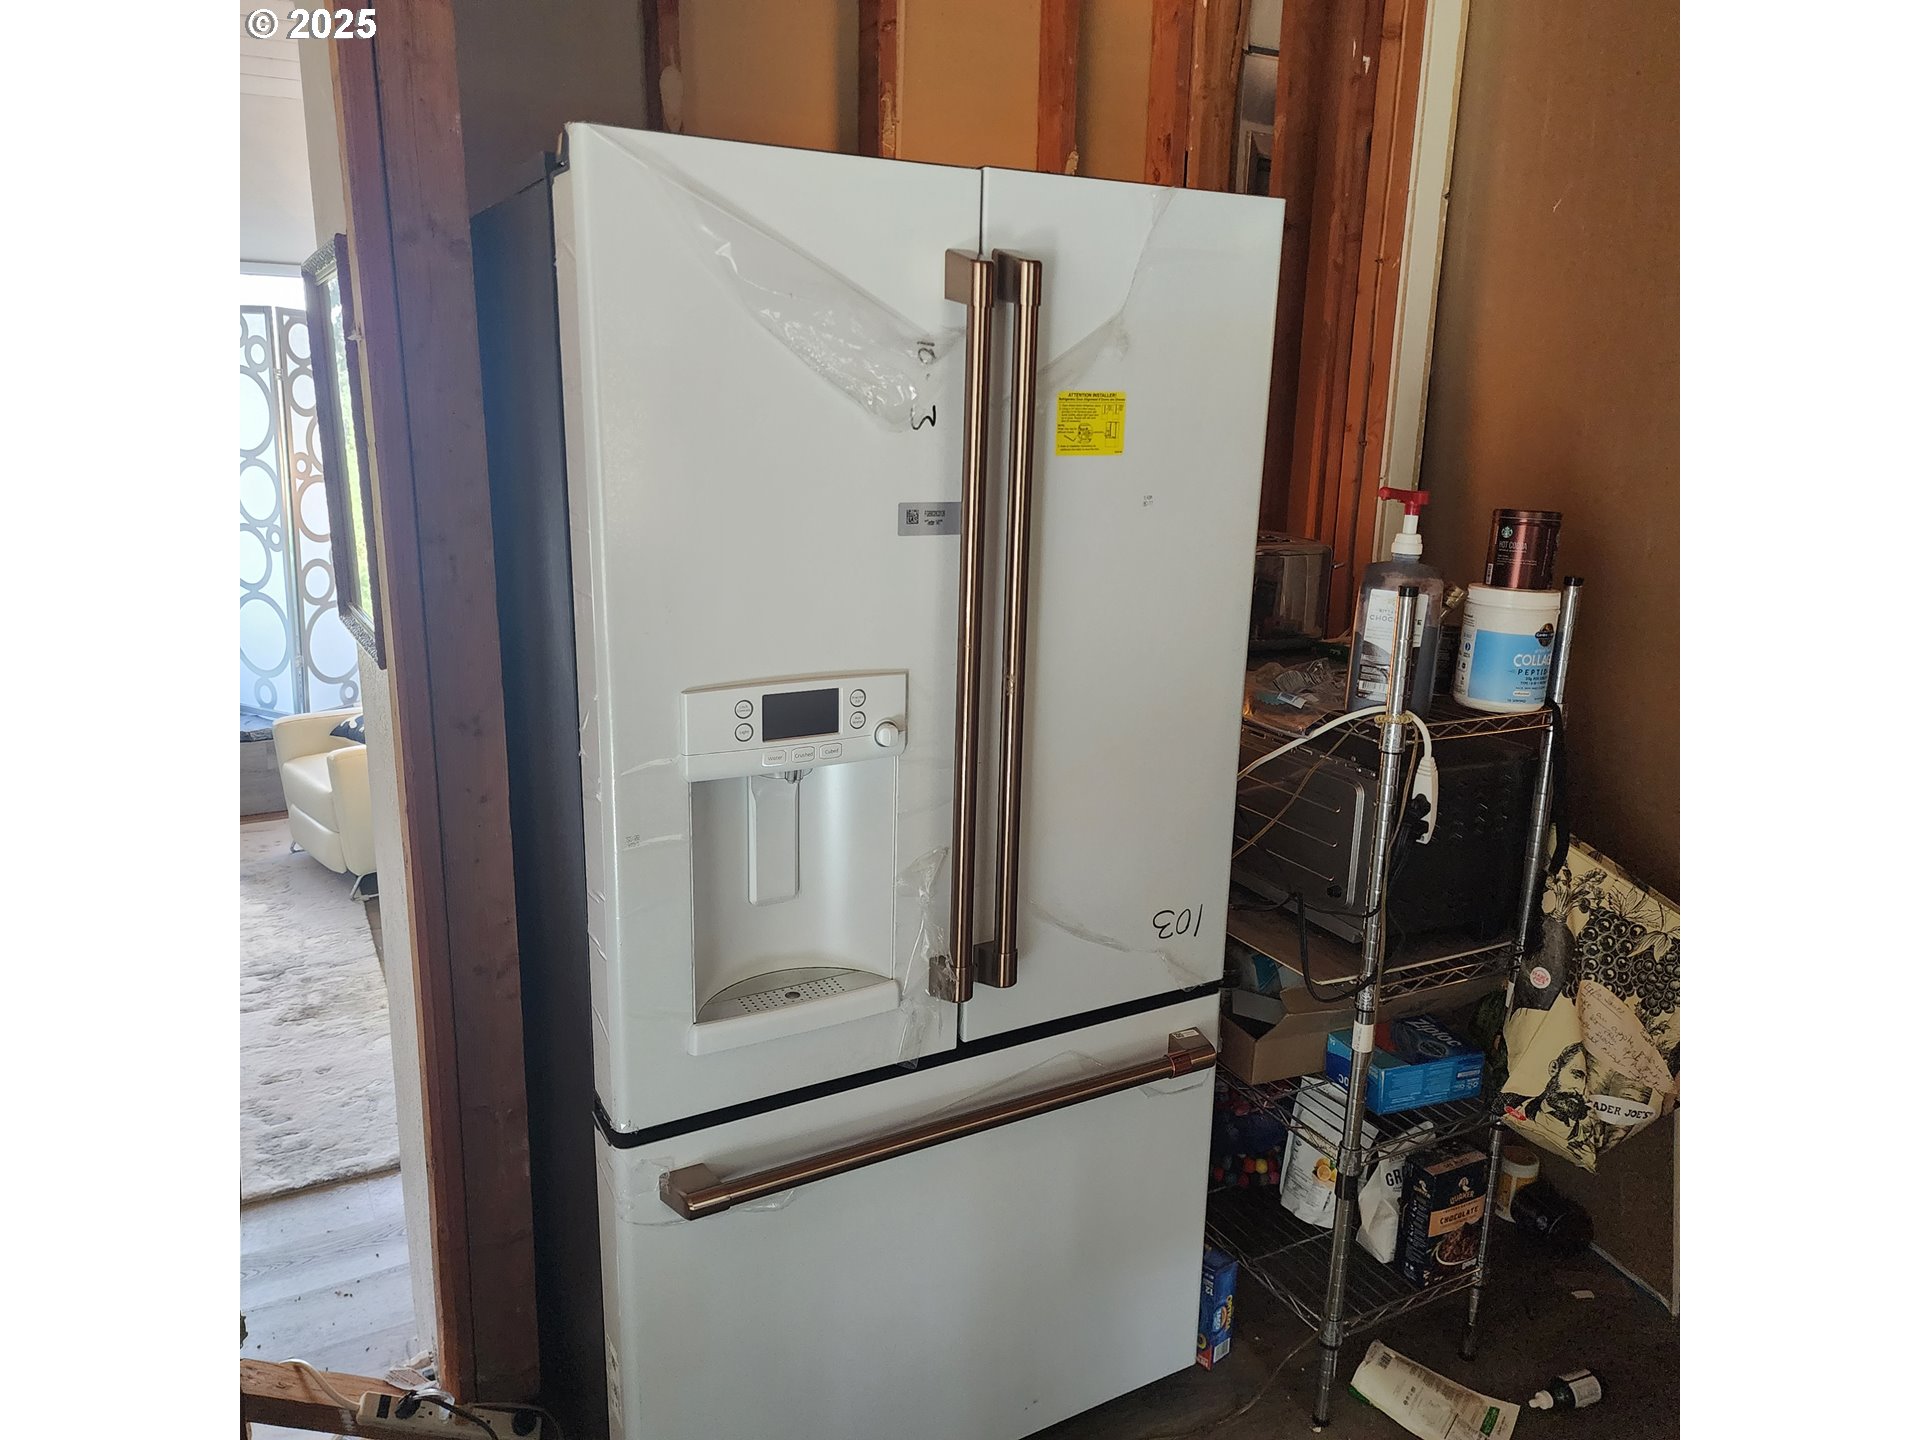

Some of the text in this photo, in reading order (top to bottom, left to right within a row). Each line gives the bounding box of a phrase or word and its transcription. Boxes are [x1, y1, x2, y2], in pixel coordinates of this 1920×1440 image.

[1406, 1018, 1463, 1048] Ziploc
[1593, 1101, 1621, 1116] ADER
[1439, 1205, 1479, 1225] CHOCOLATE
